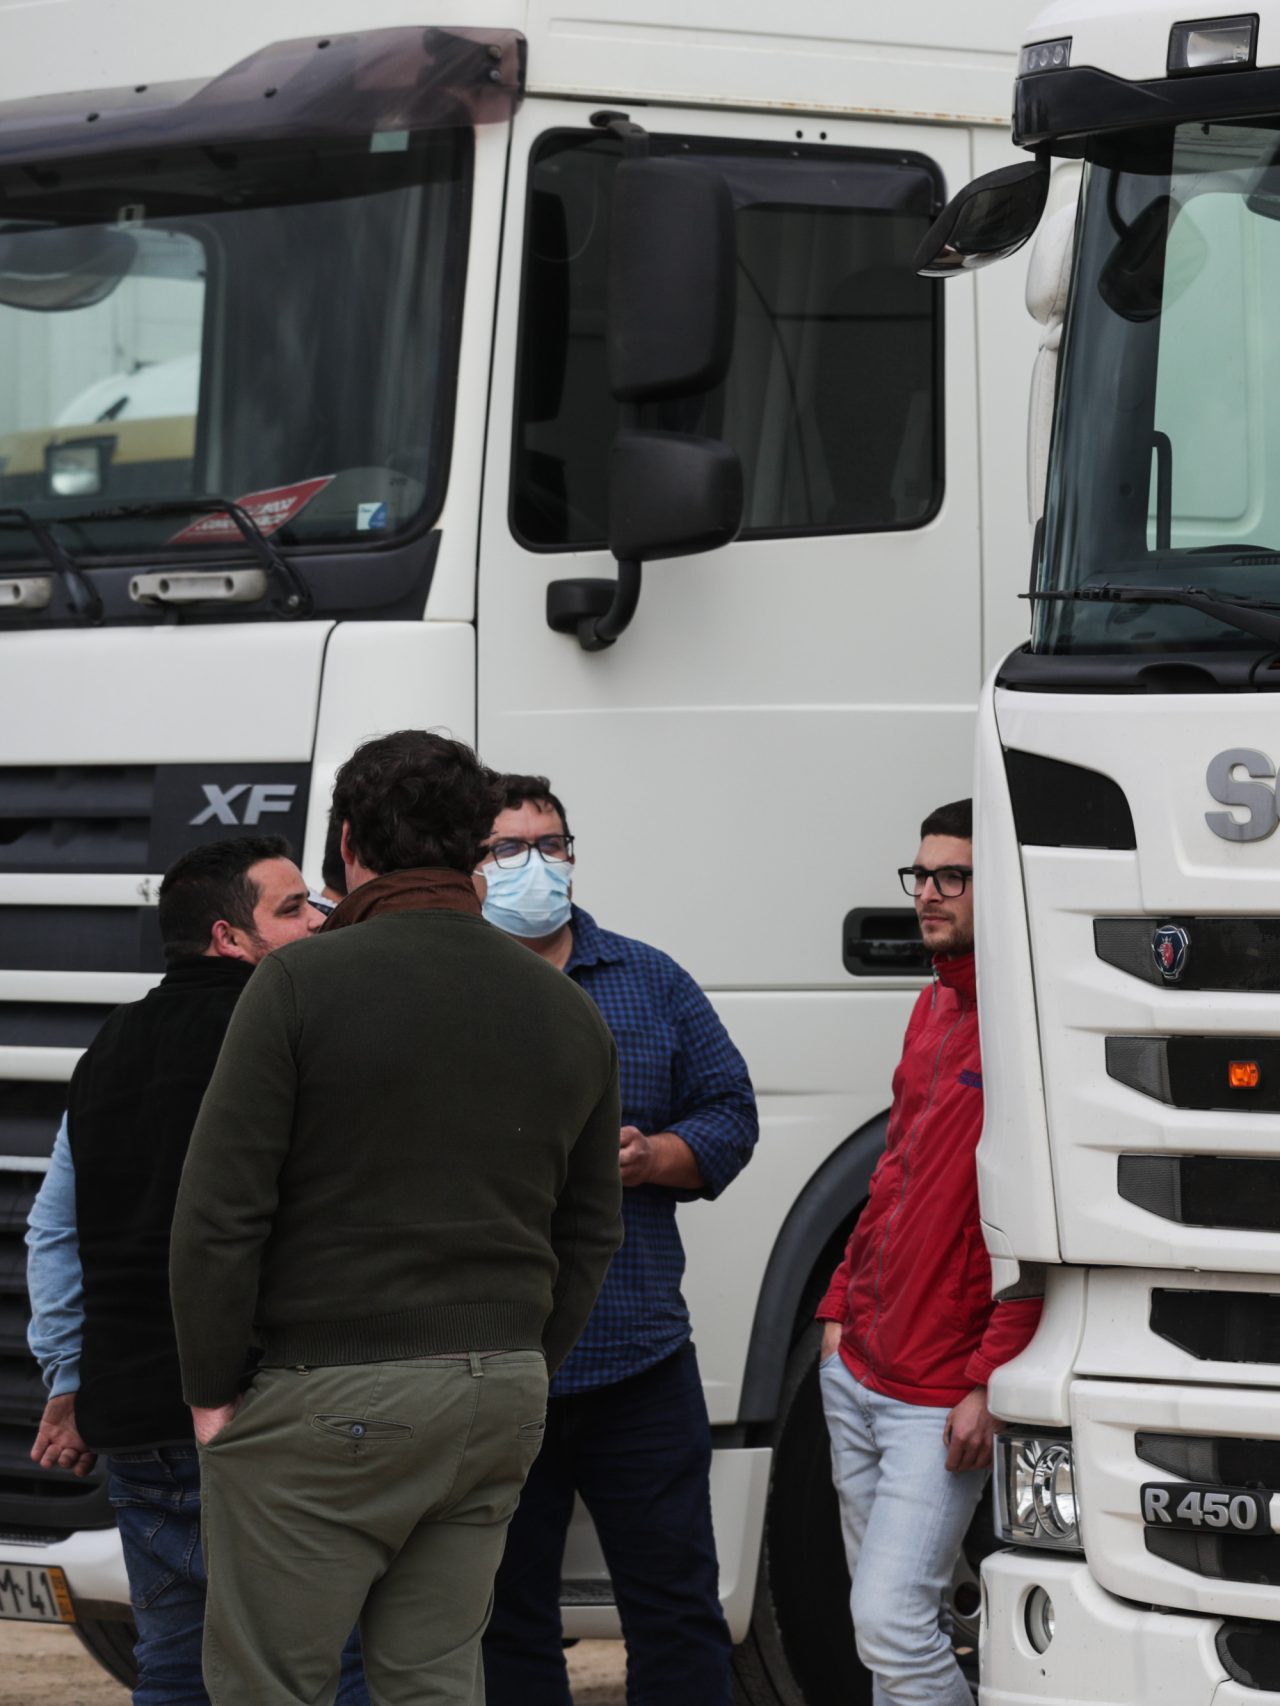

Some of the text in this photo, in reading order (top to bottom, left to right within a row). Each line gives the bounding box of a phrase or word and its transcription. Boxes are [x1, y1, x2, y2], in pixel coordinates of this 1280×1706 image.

[188, 784, 298, 825] XF
[1144, 1487, 1258, 1531] R 450
